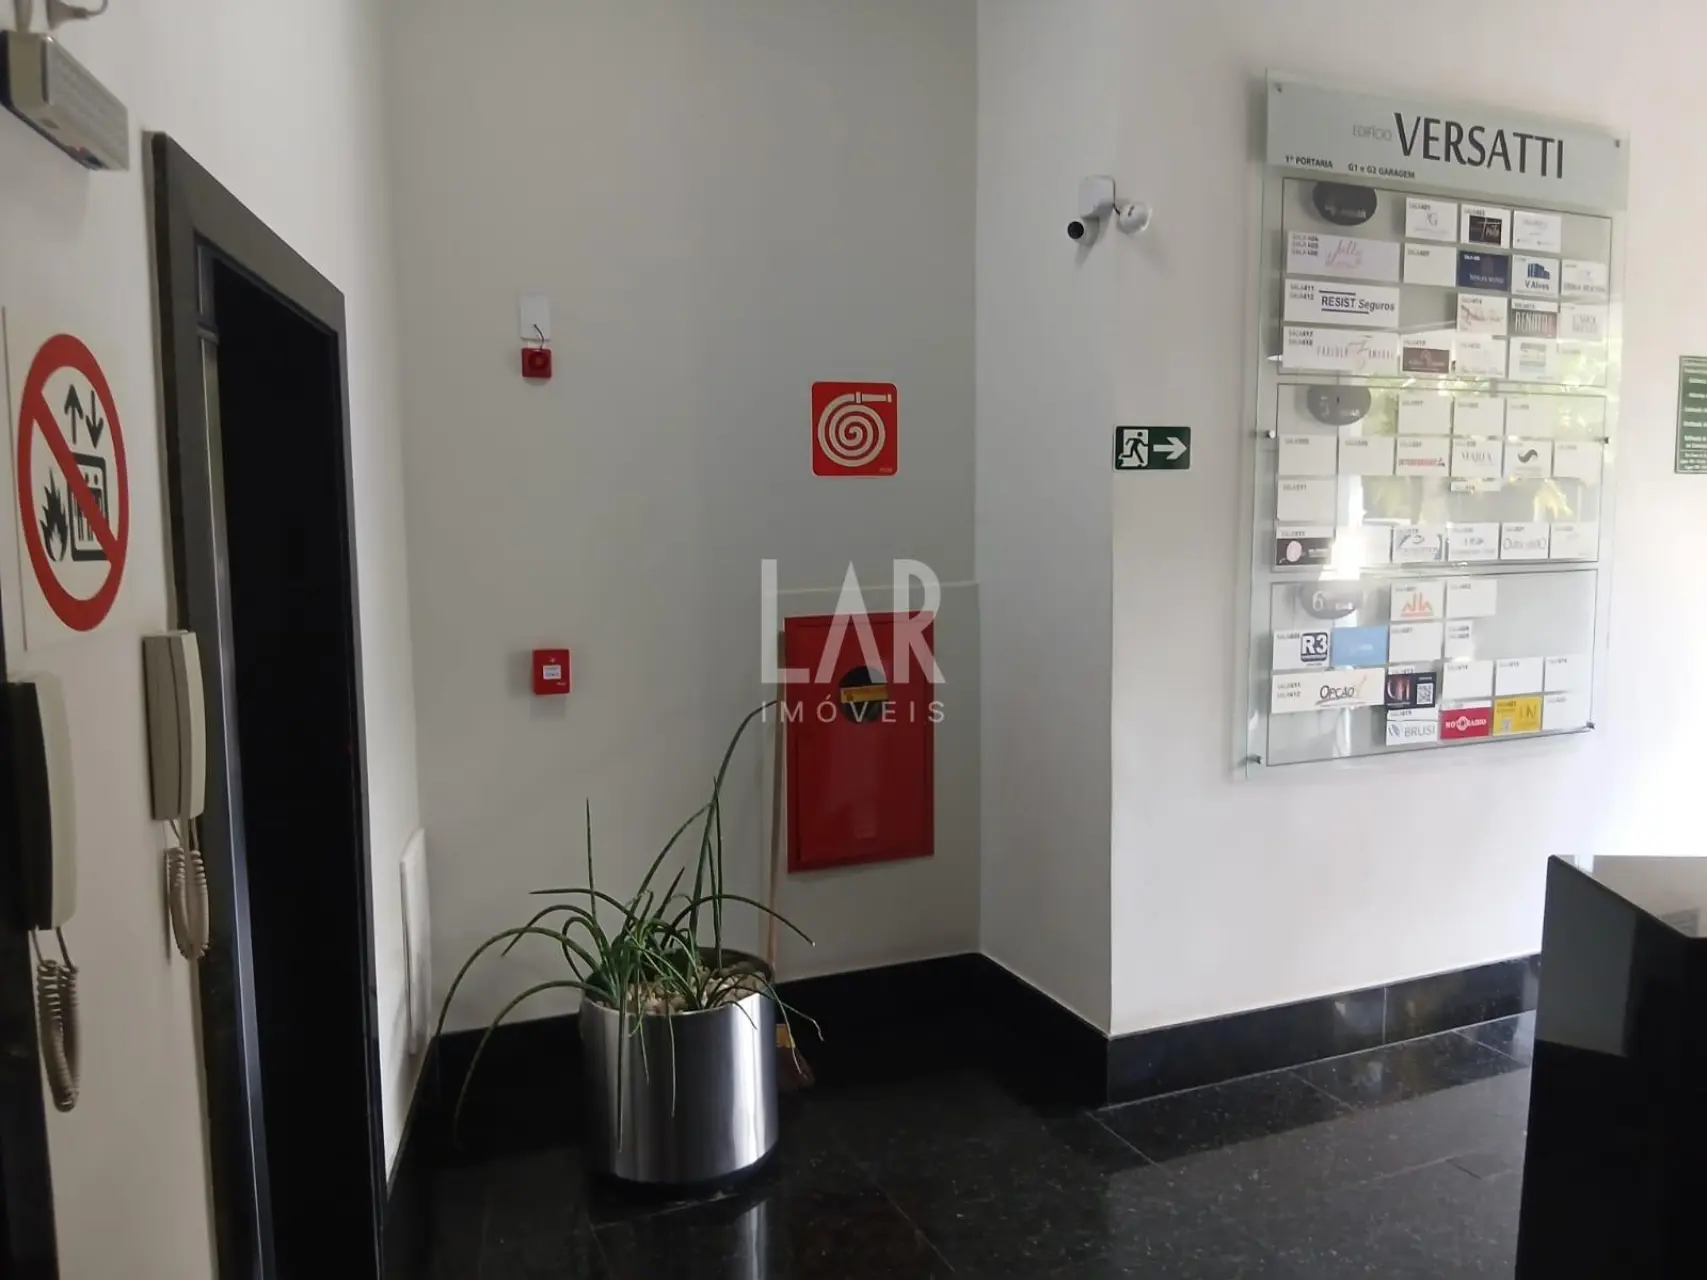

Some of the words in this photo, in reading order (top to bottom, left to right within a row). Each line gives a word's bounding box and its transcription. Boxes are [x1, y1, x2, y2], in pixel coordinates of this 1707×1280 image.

[1394, 112, 1563, 179] VERSATTI
[1295, 157, 1333, 169] PORTARIA
[1348, 163, 1358, 172] G1
[1367, 165, 1377, 174] G2
[1378, 167, 1416, 179] GARAGEM
[1321, 295, 1356, 308] RESIST
[1358, 299, 1395, 312] Seguros
[1301, 634, 1328, 655] R3
[1404, 724, 1436, 737] BRUSI
